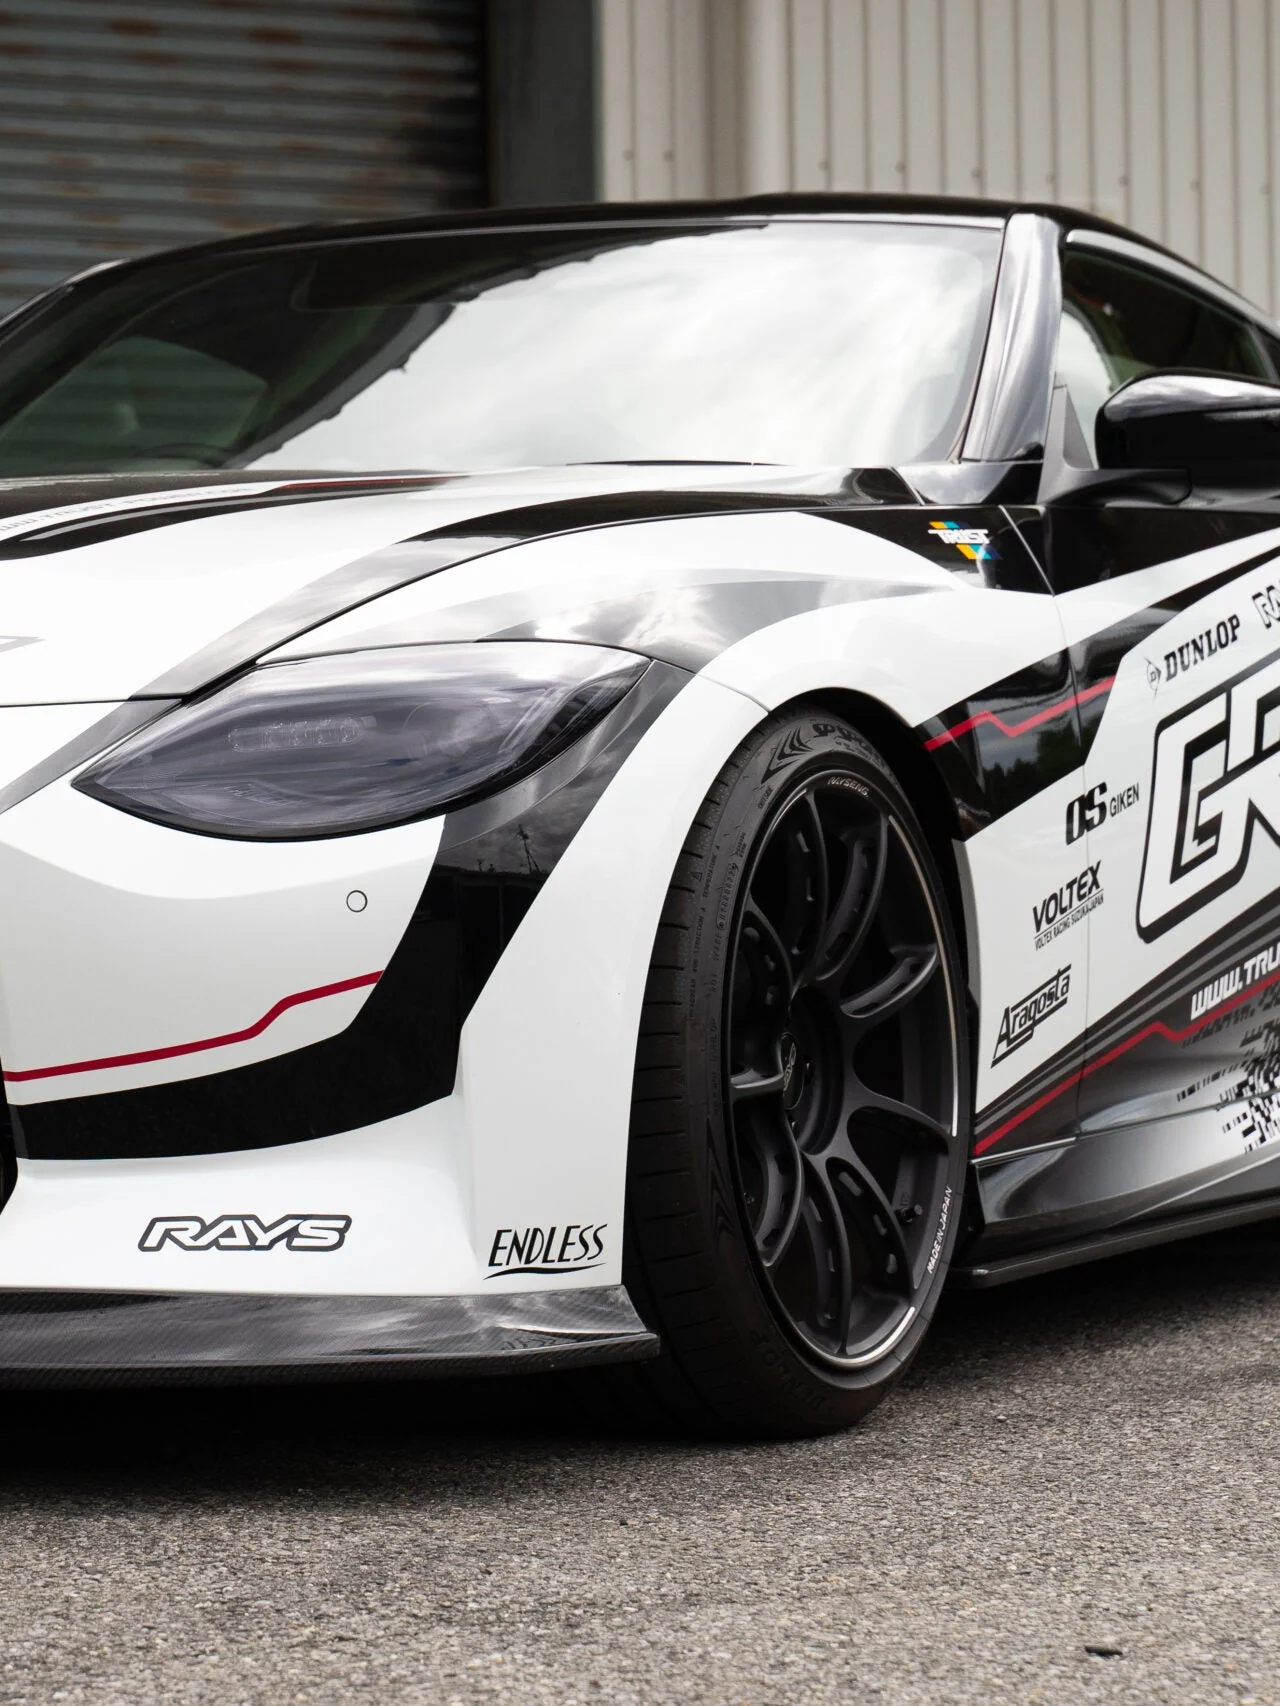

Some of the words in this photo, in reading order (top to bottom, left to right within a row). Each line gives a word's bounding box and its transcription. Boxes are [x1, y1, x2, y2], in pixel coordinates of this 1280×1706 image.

[1164, 614, 1241, 682] DUNLOP
[1065, 782, 1107, 845] OS
[1109, 782, 1140, 818] GIKEN
[1032, 860, 1102, 933] VOLTEX
[991, 965, 1072, 1066] Aragosta
[138, 1214, 352, 1252] RAYS
[488, 1223, 608, 1267] ENDLESS
[926, 1239, 941, 1274] MADE
[939, 1185, 953, 1231] JAPAN
